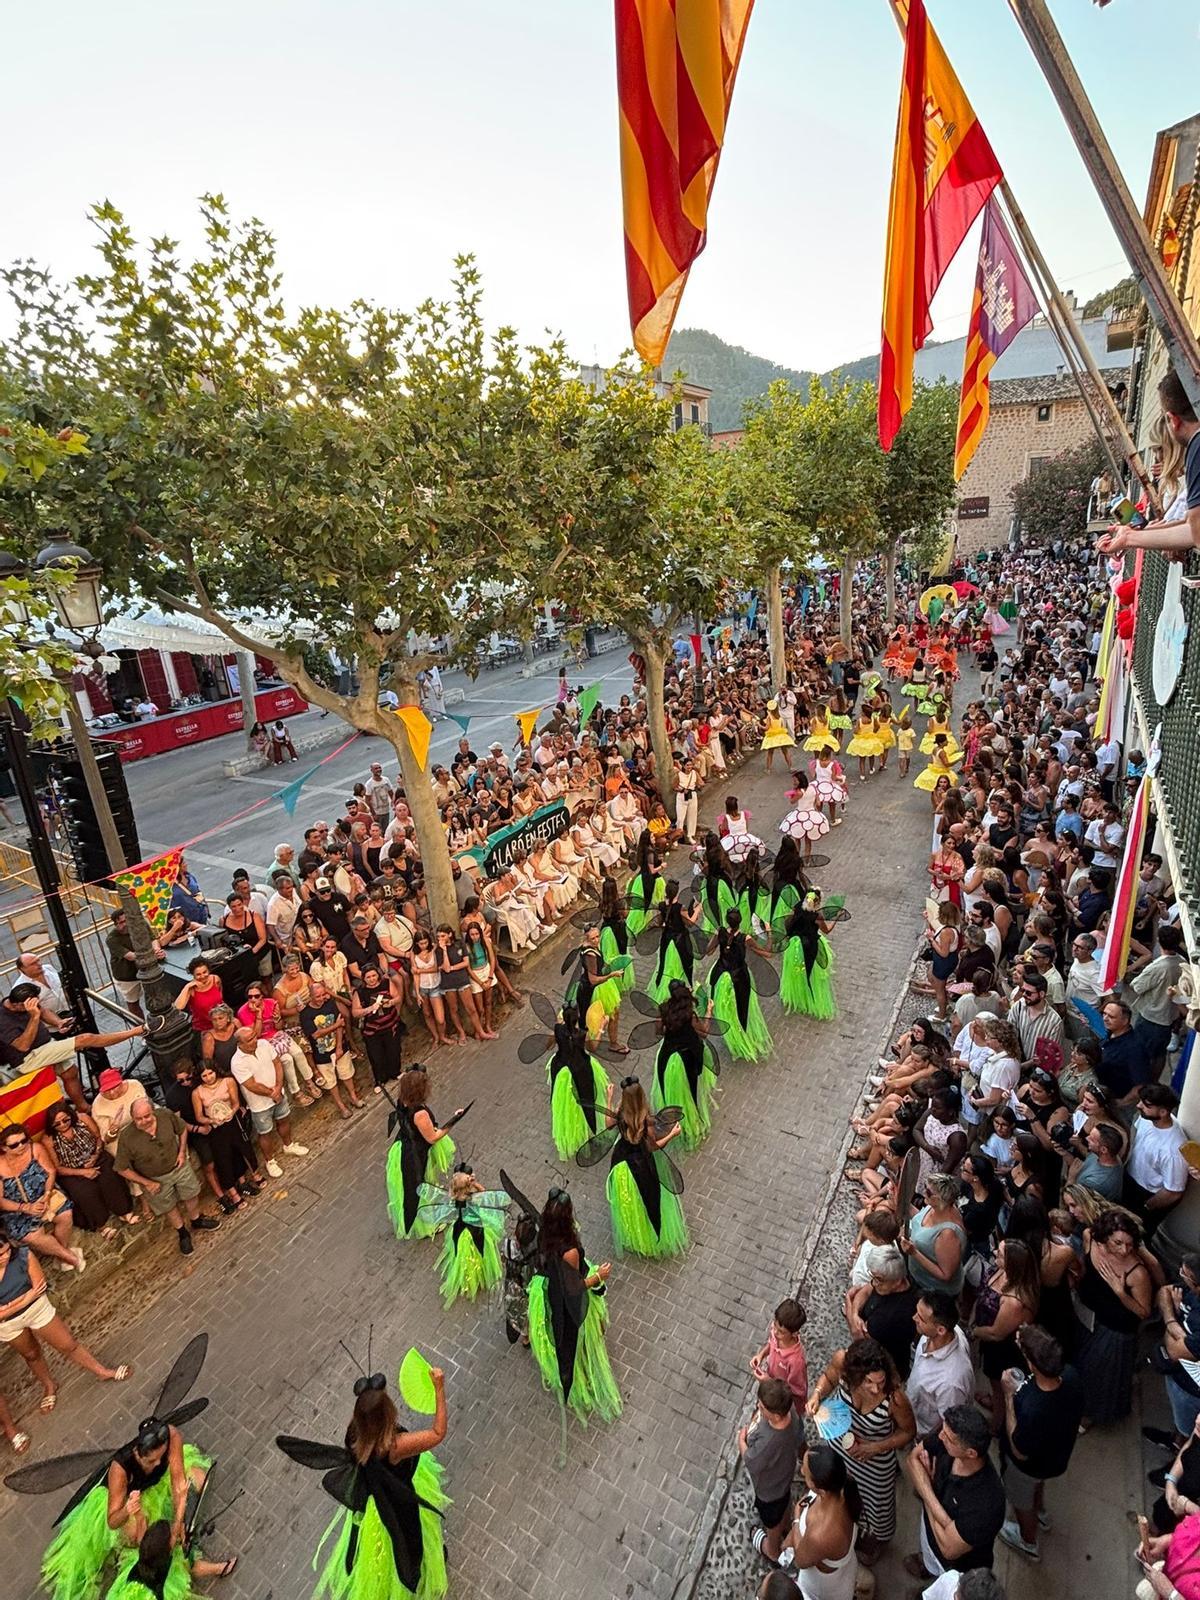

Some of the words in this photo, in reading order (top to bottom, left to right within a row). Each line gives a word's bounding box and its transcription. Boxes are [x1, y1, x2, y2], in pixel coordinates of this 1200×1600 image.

[175, 723, 198, 733] ESTRELLA
[525, 830, 536, 849] EN
[537, 811, 566, 839] FESTES
[383, 885, 392, 897] B
